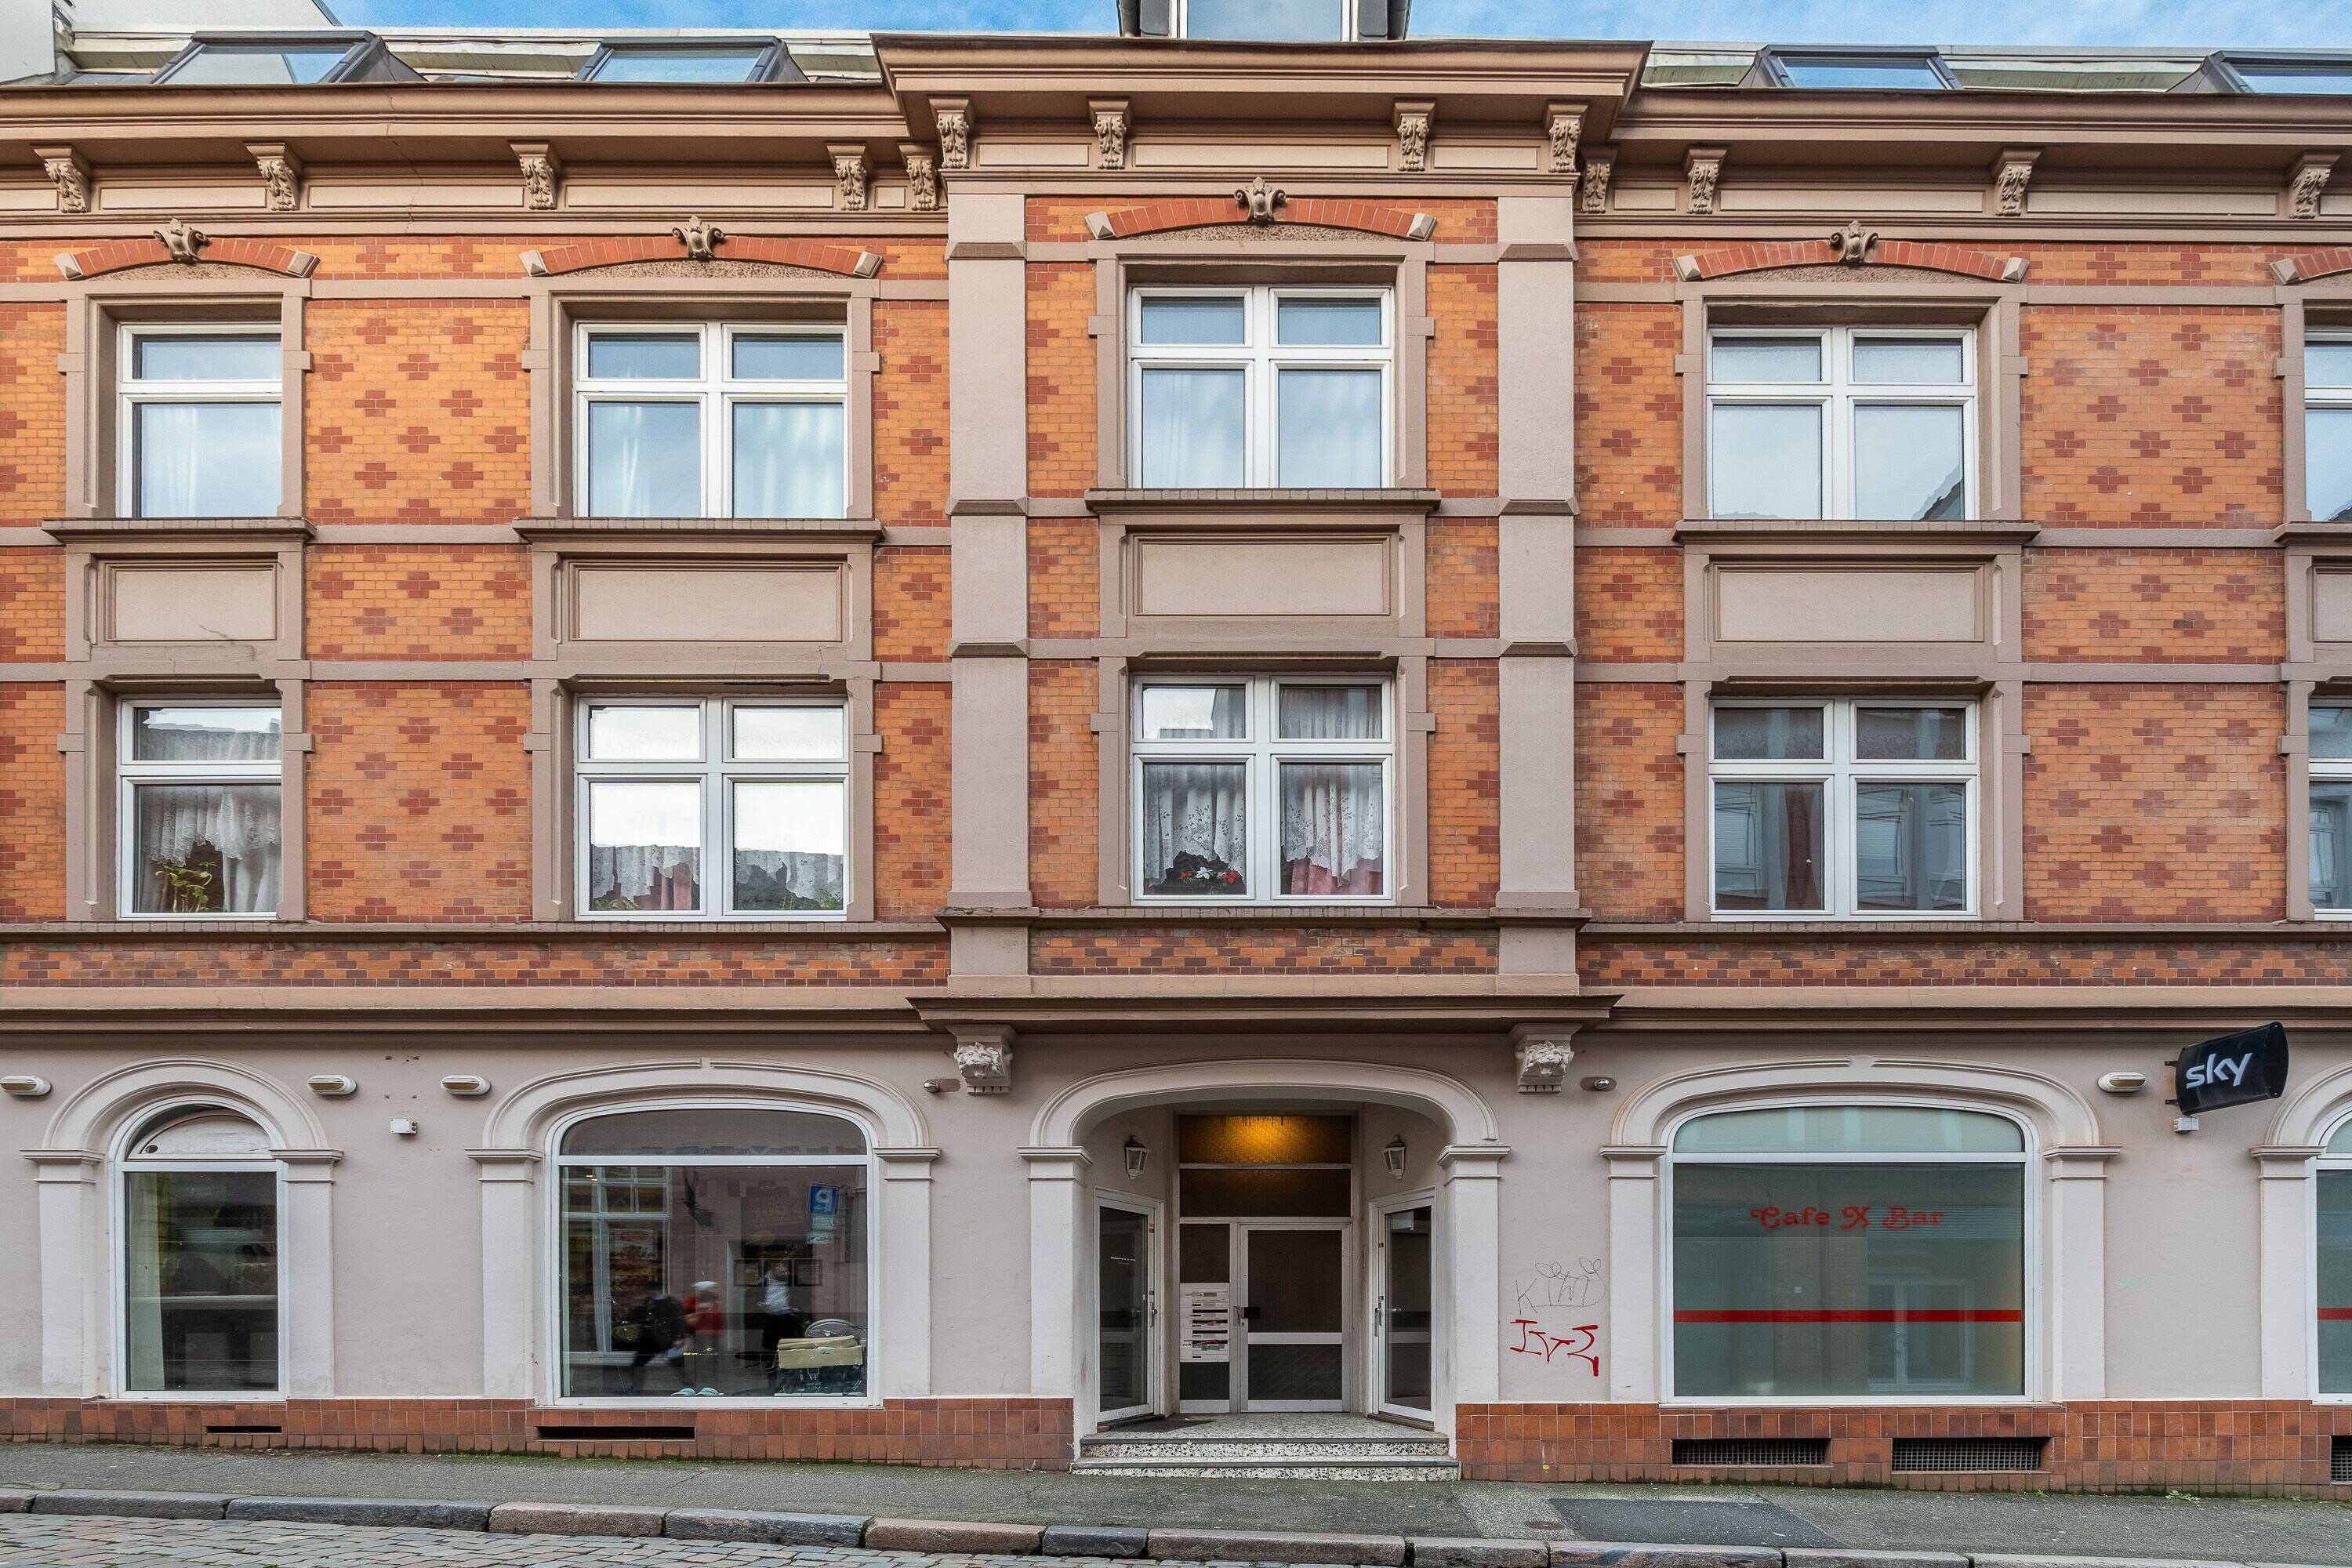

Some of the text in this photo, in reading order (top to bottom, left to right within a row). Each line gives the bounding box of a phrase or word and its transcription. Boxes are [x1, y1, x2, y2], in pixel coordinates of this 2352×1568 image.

[2186, 1053, 2253, 1089] sky
[1750, 1206, 1831, 1229] Cafe
[1882, 1205, 1944, 1230] Bar
